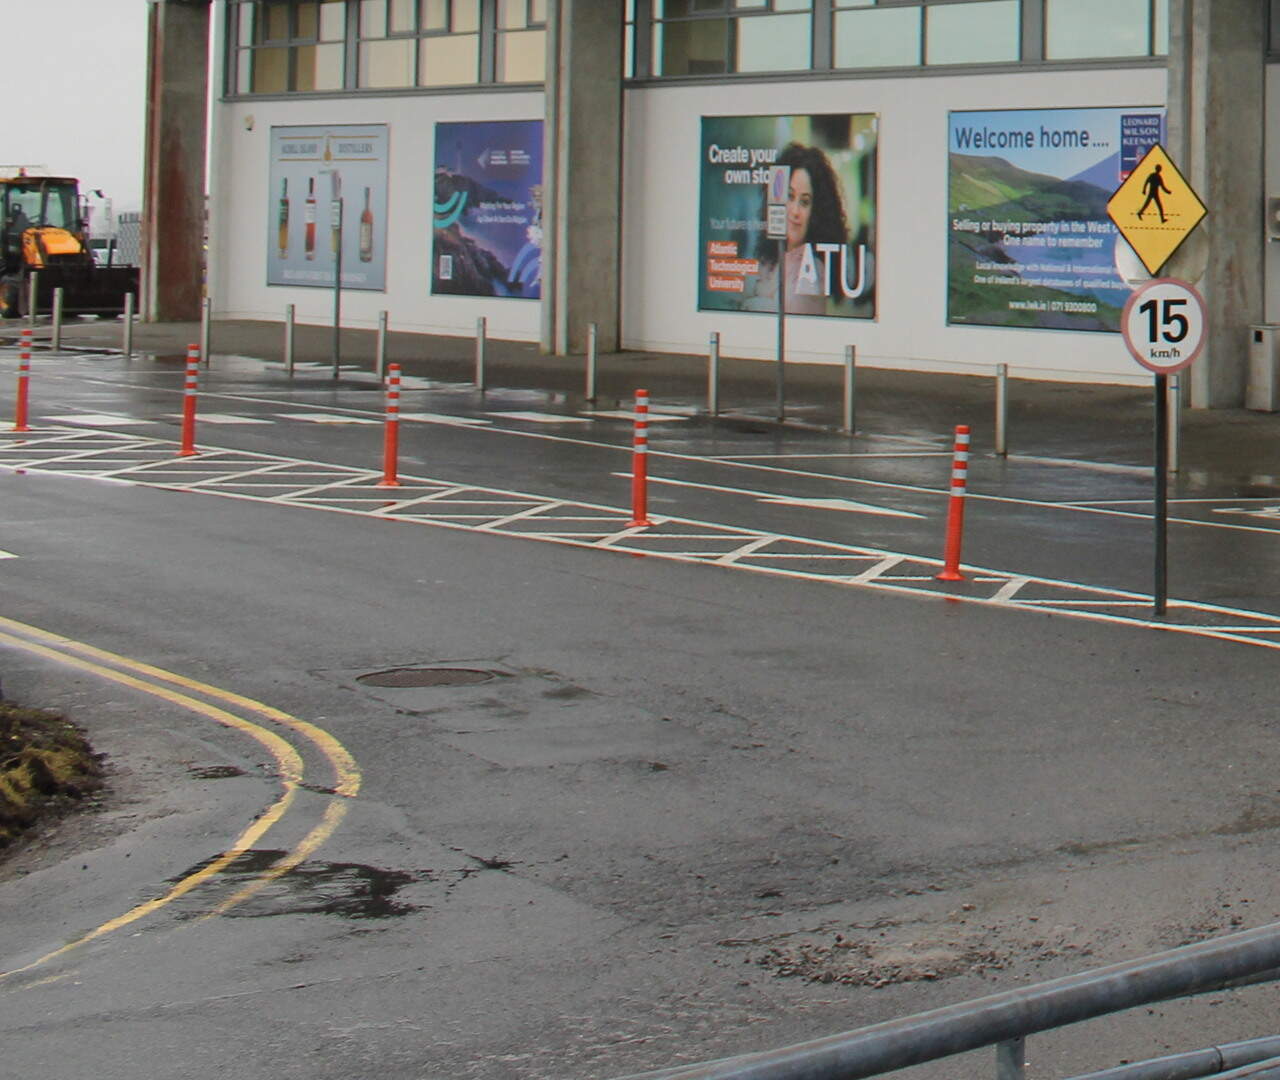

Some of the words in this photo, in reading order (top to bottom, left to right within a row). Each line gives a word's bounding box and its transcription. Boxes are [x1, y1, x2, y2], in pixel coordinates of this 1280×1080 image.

[1123, 118, 1159, 127] LEONARD
[955, 126, 1035, 149] Welcome
[1123, 127, 1160, 136] WILSON
[709, 144, 749, 164] Create
[750, 147, 777, 168] your
[725, 170, 751, 184] own
[953, 219, 980, 233] Selling
[982, 221, 992, 231] or
[992, 220, 1022, 234] buying
[1022, 221, 1060, 235] property
[1061, 221, 1070, 232] in
[1071, 221, 1086, 233] the
[1087, 222, 1109, 234] West
[710, 243, 738, 256] Atlantic
[1003, 236, 1021, 247] One
[1023, 237, 1046, 247] name
[1047, 237, 1057, 247] to
[1058, 236, 1104, 249] remember
[710, 260, 760, 275] Technological
[795, 242, 866, 299] ATU
[710, 277, 744, 293] University
[1139, 298, 1189, 343] 15
[1150, 347, 1180, 359] km/h
